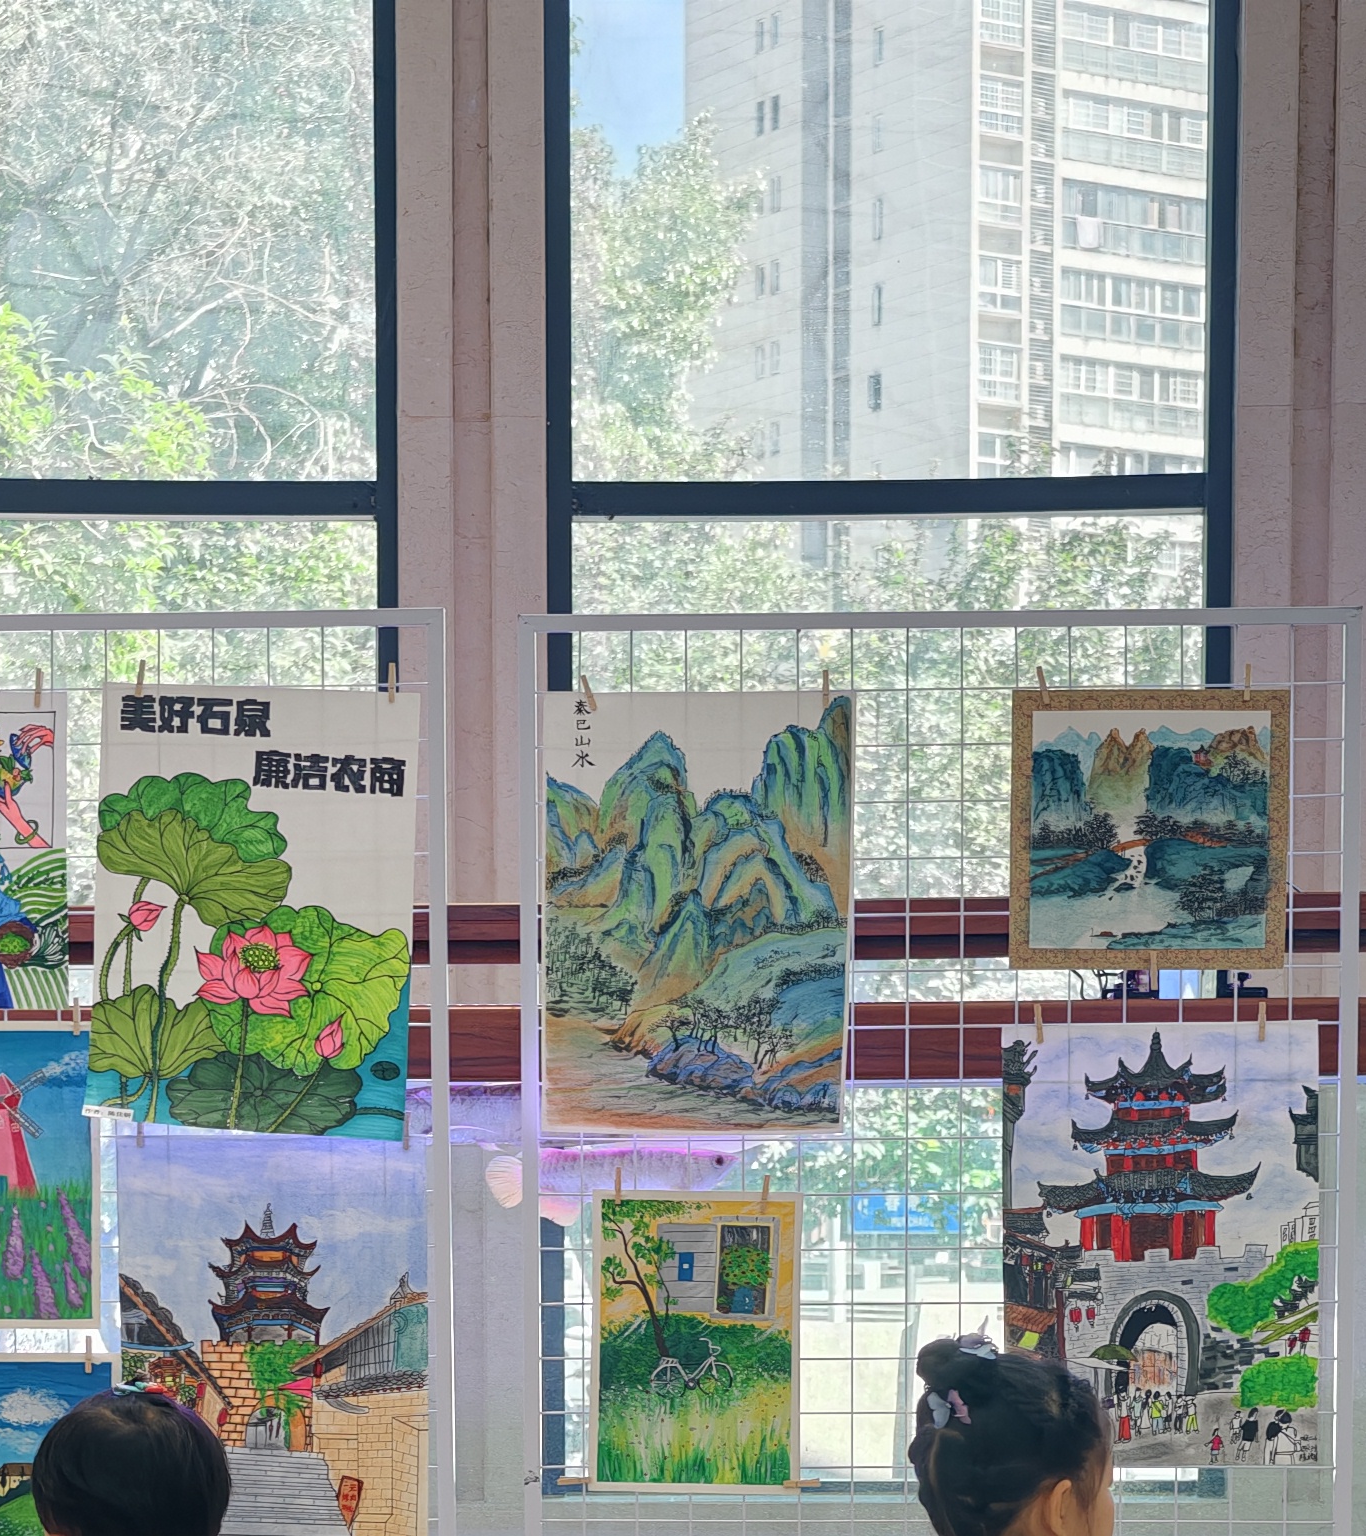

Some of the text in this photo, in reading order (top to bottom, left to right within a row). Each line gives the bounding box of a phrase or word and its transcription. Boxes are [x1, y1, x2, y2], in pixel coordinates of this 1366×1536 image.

[119, 695, 273, 738] 美好石泉
[252, 750, 407, 798] 廉洁农商
